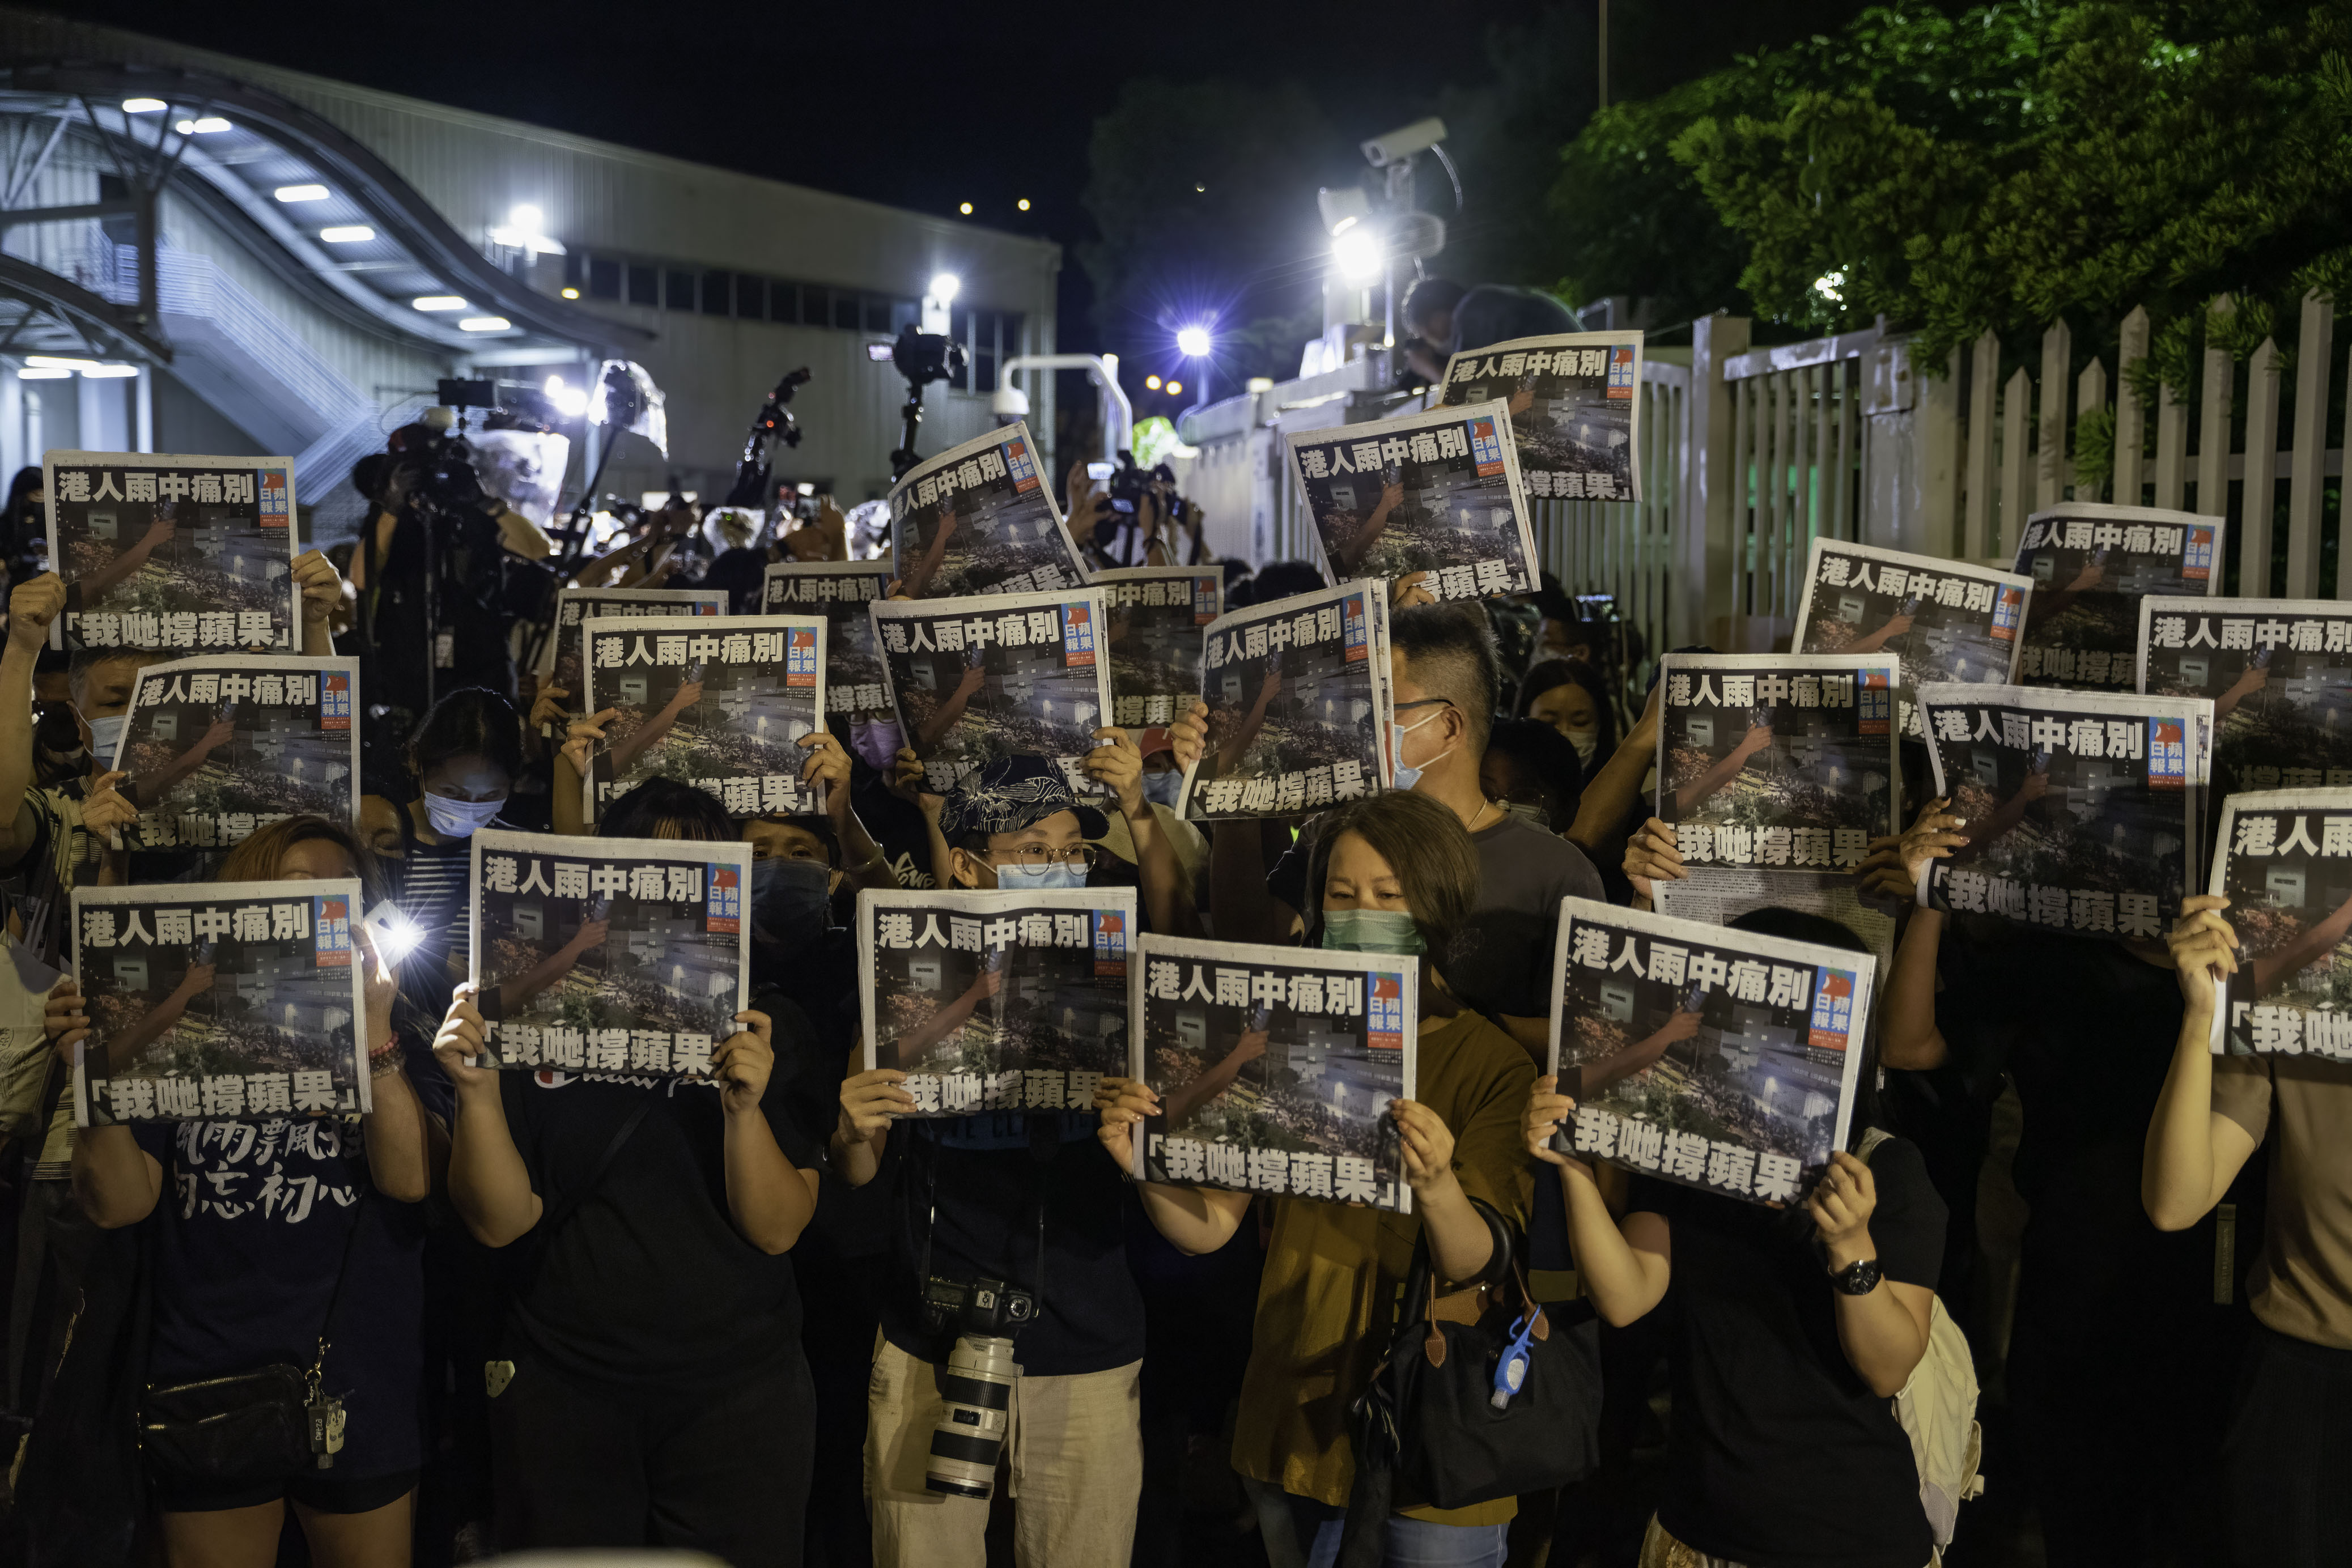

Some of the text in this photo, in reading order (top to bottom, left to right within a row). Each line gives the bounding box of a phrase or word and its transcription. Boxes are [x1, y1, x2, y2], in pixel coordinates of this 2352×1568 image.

[1452, 349, 1607, 384] 港人雨中痛別
[1301, 427, 1468, 479] 港人雨中痛別
[58, 471, 253, 504] 港人雨中痛別
[2023, 522, 2182, 555] 港人雨中痛別
[770, 577, 881, 603] 港人雨中痛別
[1820, 556, 1996, 613] 港人雨中痛別
[66, 611, 289, 648] 「我哋撐蘋果」
[595, 632, 784, 668] 港人雨中痛別
[882, 610, 1059, 654] 港人雨中痛別
[1207, 605, 1341, 669] 港人雨中痛別
[139, 674, 316, 707] 港人雨中痛別
[1668, 674, 1853, 707] 港人雨中痛別
[1933, 710, 2143, 759] 港人雨中痛別
[484, 856, 702, 903] 港人雨中痛別
[82, 903, 310, 947] 港人雨中痛別
[878, 913, 1089, 953] 港人雨中痛別
[1148, 961, 1362, 1015] 港人雨中痛別
[1572, 926, 1811, 1011] 港人雨中痛別
[92, 1069, 355, 1121] 「我哋撐蘋果」
[1148, 1133, 1395, 1207] 「我哋撐蘋果」
[1560, 1107, 1803, 1204] 我哋撐蘋果
